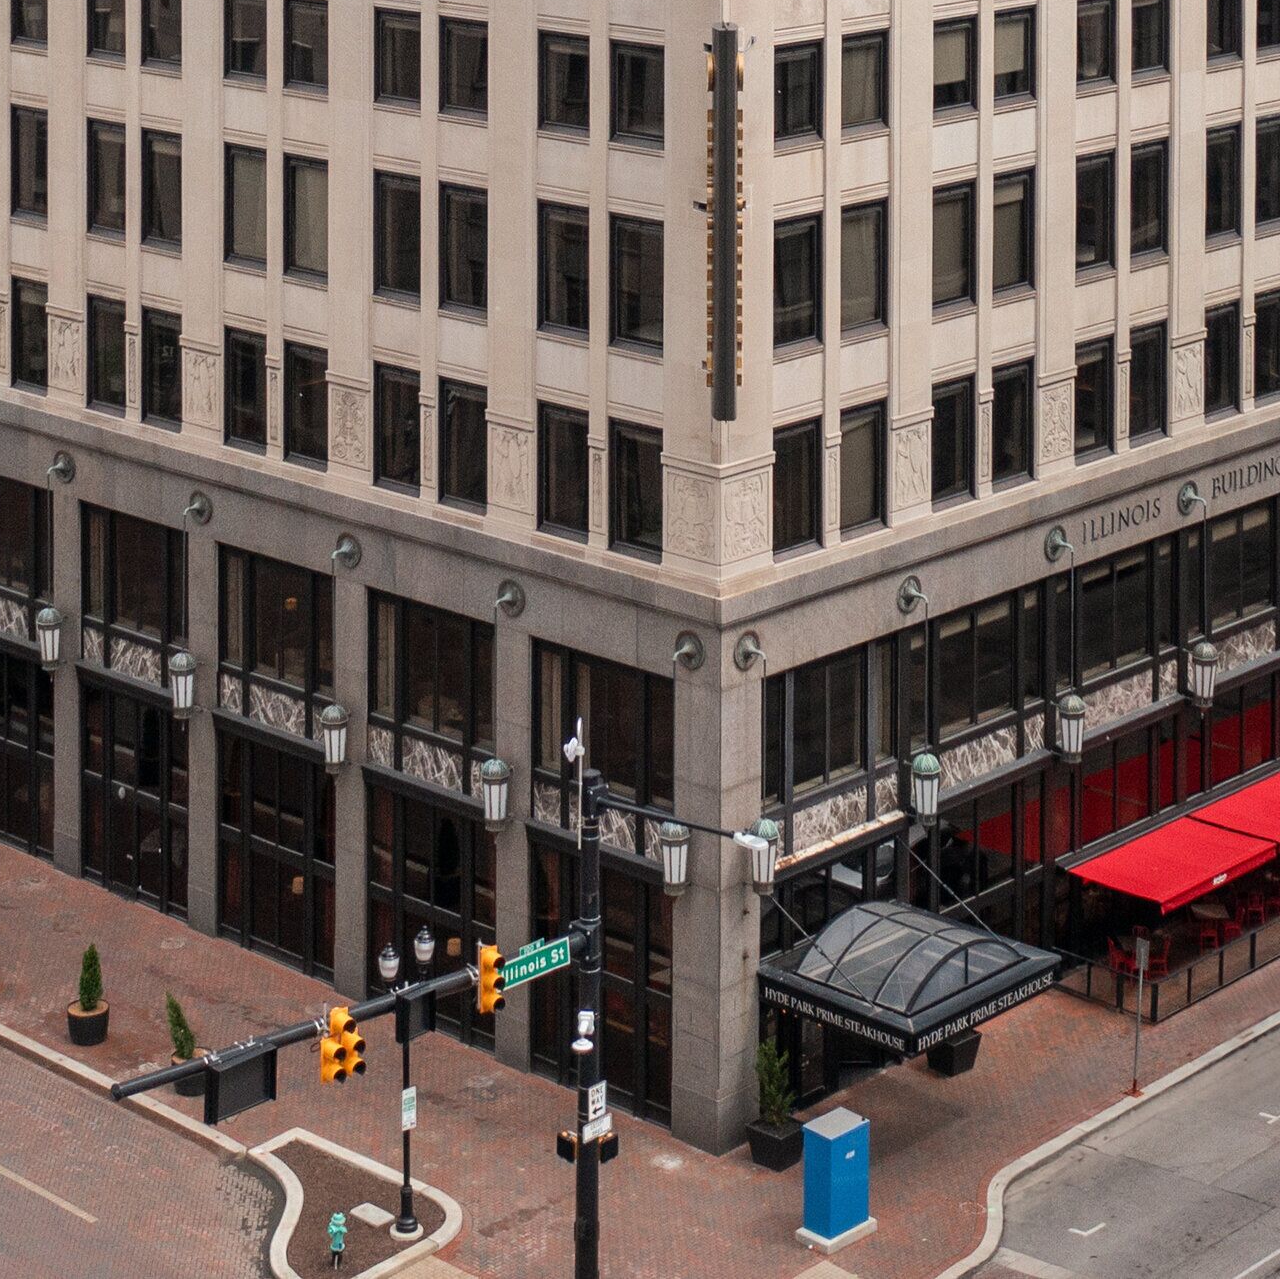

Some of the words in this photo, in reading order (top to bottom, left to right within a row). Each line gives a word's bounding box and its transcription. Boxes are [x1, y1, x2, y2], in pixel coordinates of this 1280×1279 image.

[1082, 497, 1161, 545] ILLINOIS
[551, 946, 565, 964] St
[764, 987, 790, 1006] HYDE
[791, 998, 815, 1017] PARK
[816, 1008, 844, 1027] PRIME
[844, 1018, 906, 1052] STEAKHOUSE
[917, 1027, 944, 1052] HYDE
[944, 1015, 970, 1038] PARK
[970, 1001, 998, 1026] PRIME
[997, 971, 1055, 1012] STEAKHOUSE
